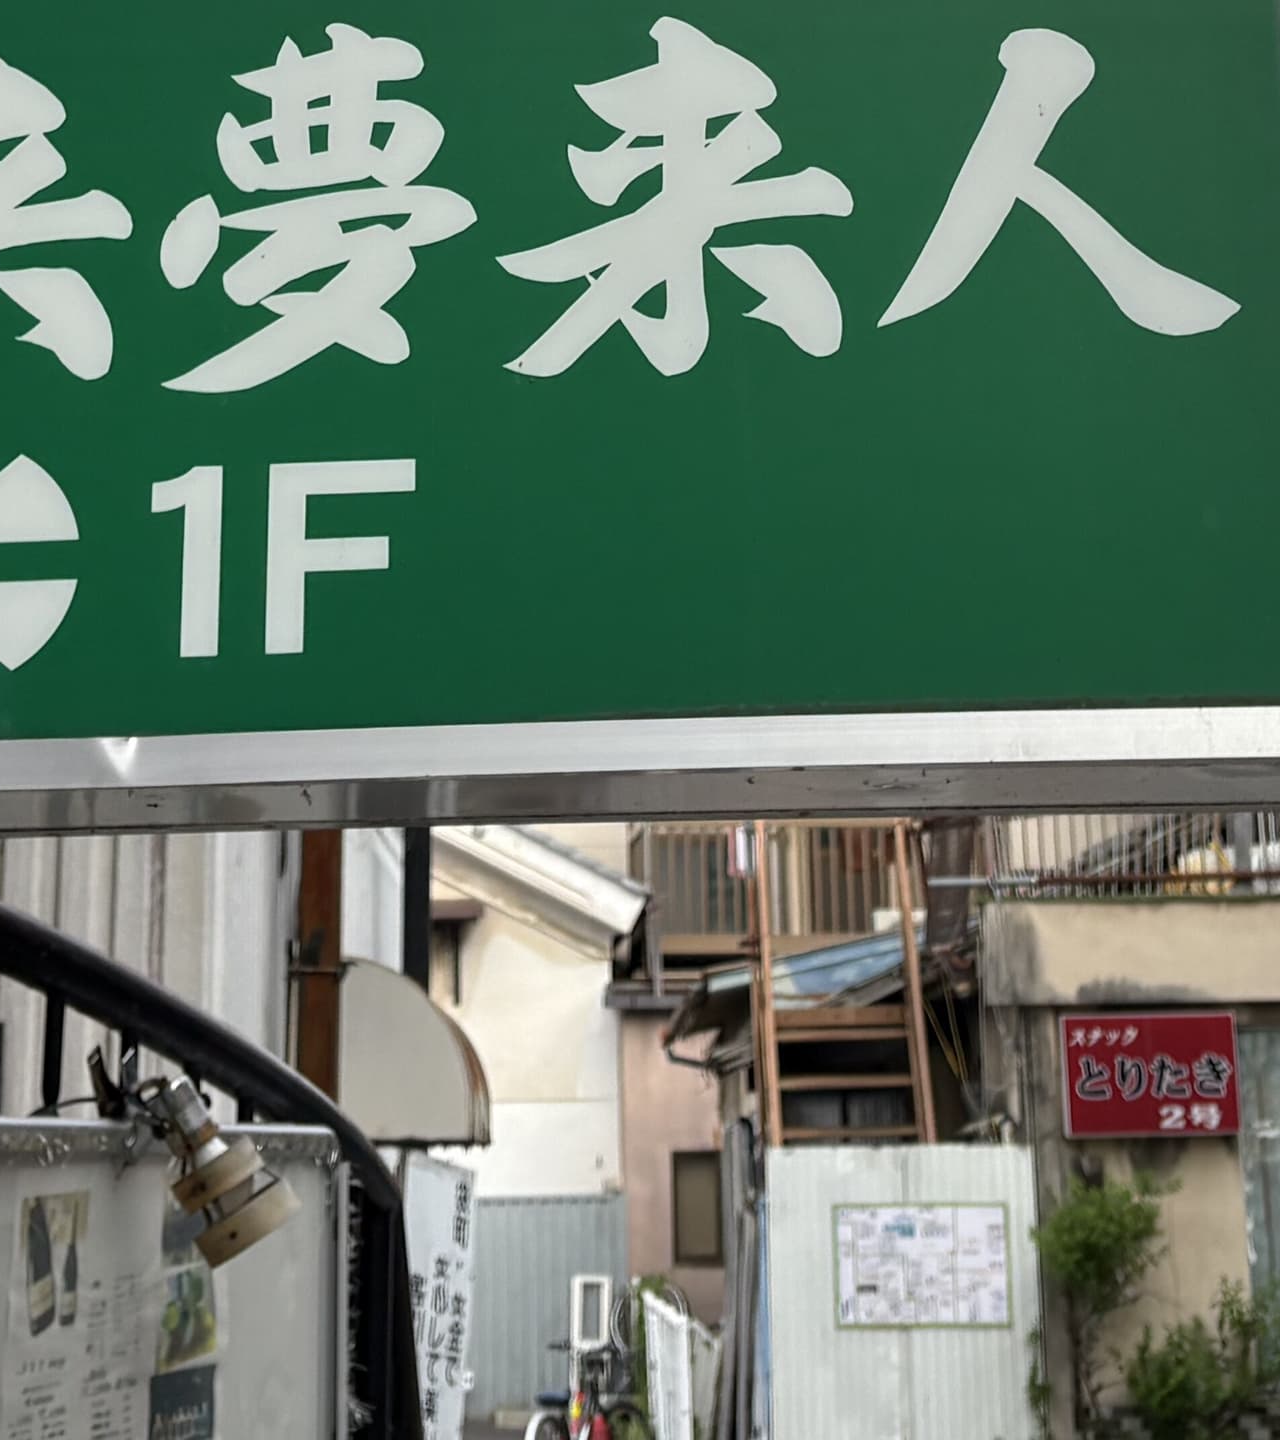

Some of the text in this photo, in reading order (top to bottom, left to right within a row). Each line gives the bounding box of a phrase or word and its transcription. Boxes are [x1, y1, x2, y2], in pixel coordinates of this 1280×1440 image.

[151, 458, 416, 658] 1F
[1070, 1024, 1139, 1048] スナック
